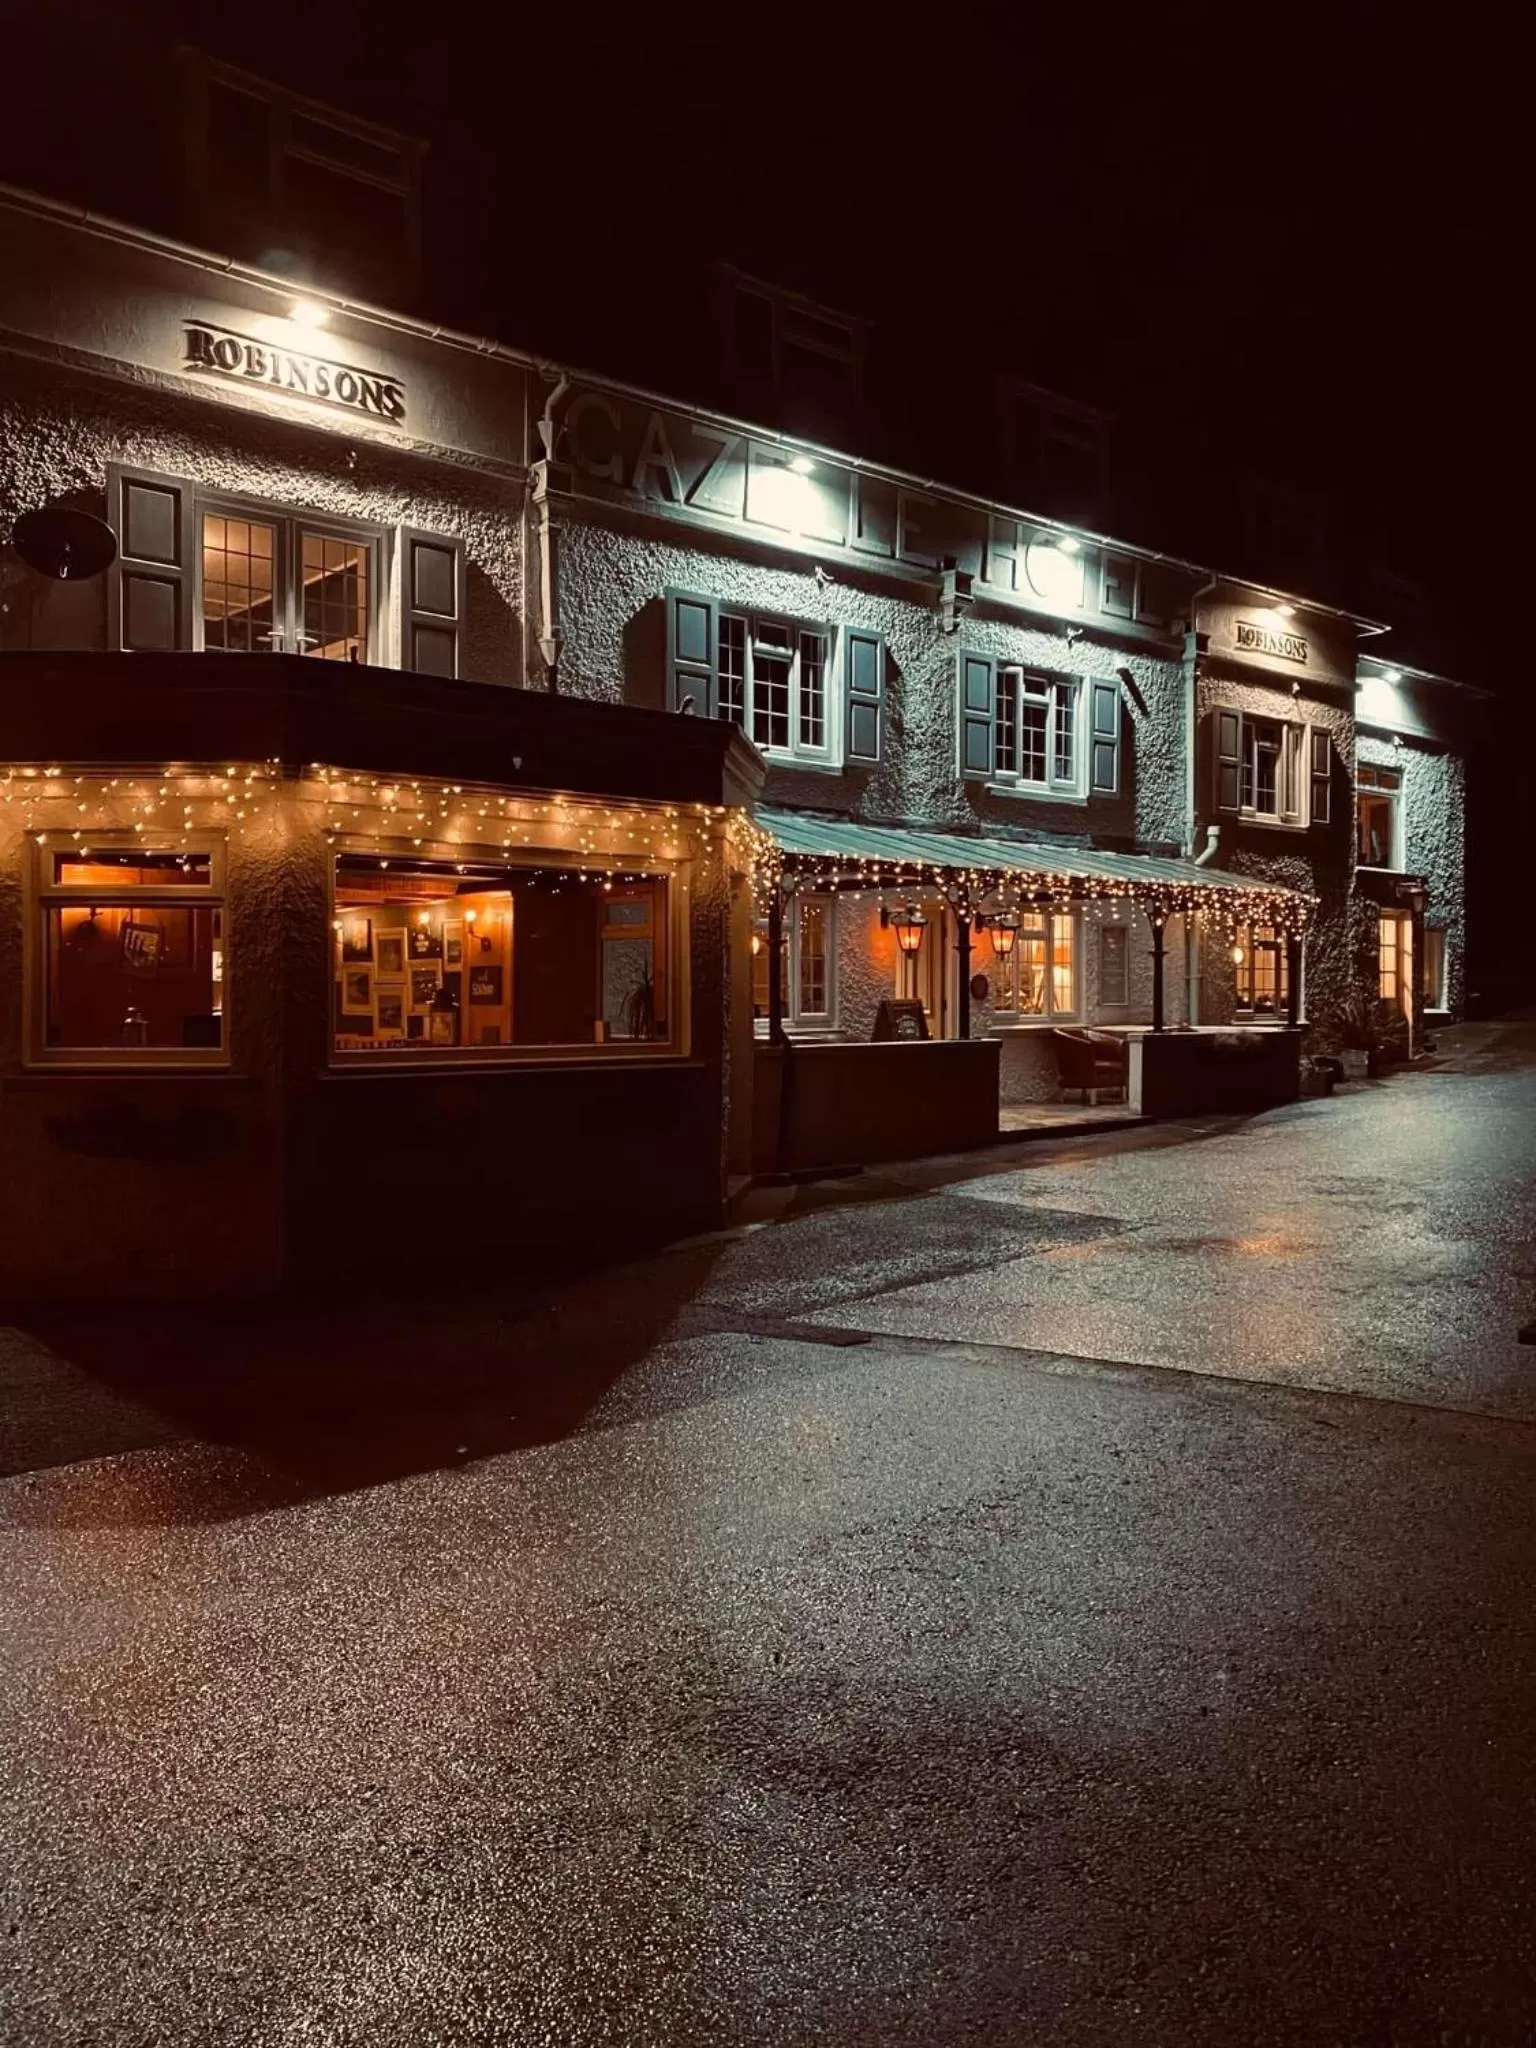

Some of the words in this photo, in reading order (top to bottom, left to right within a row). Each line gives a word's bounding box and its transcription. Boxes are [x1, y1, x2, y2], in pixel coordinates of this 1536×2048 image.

[184, 329, 406, 418] ROBINSONS
[565, 395, 937, 568] GAZELE
[1237, 625, 1308, 660] ROBINSONS
